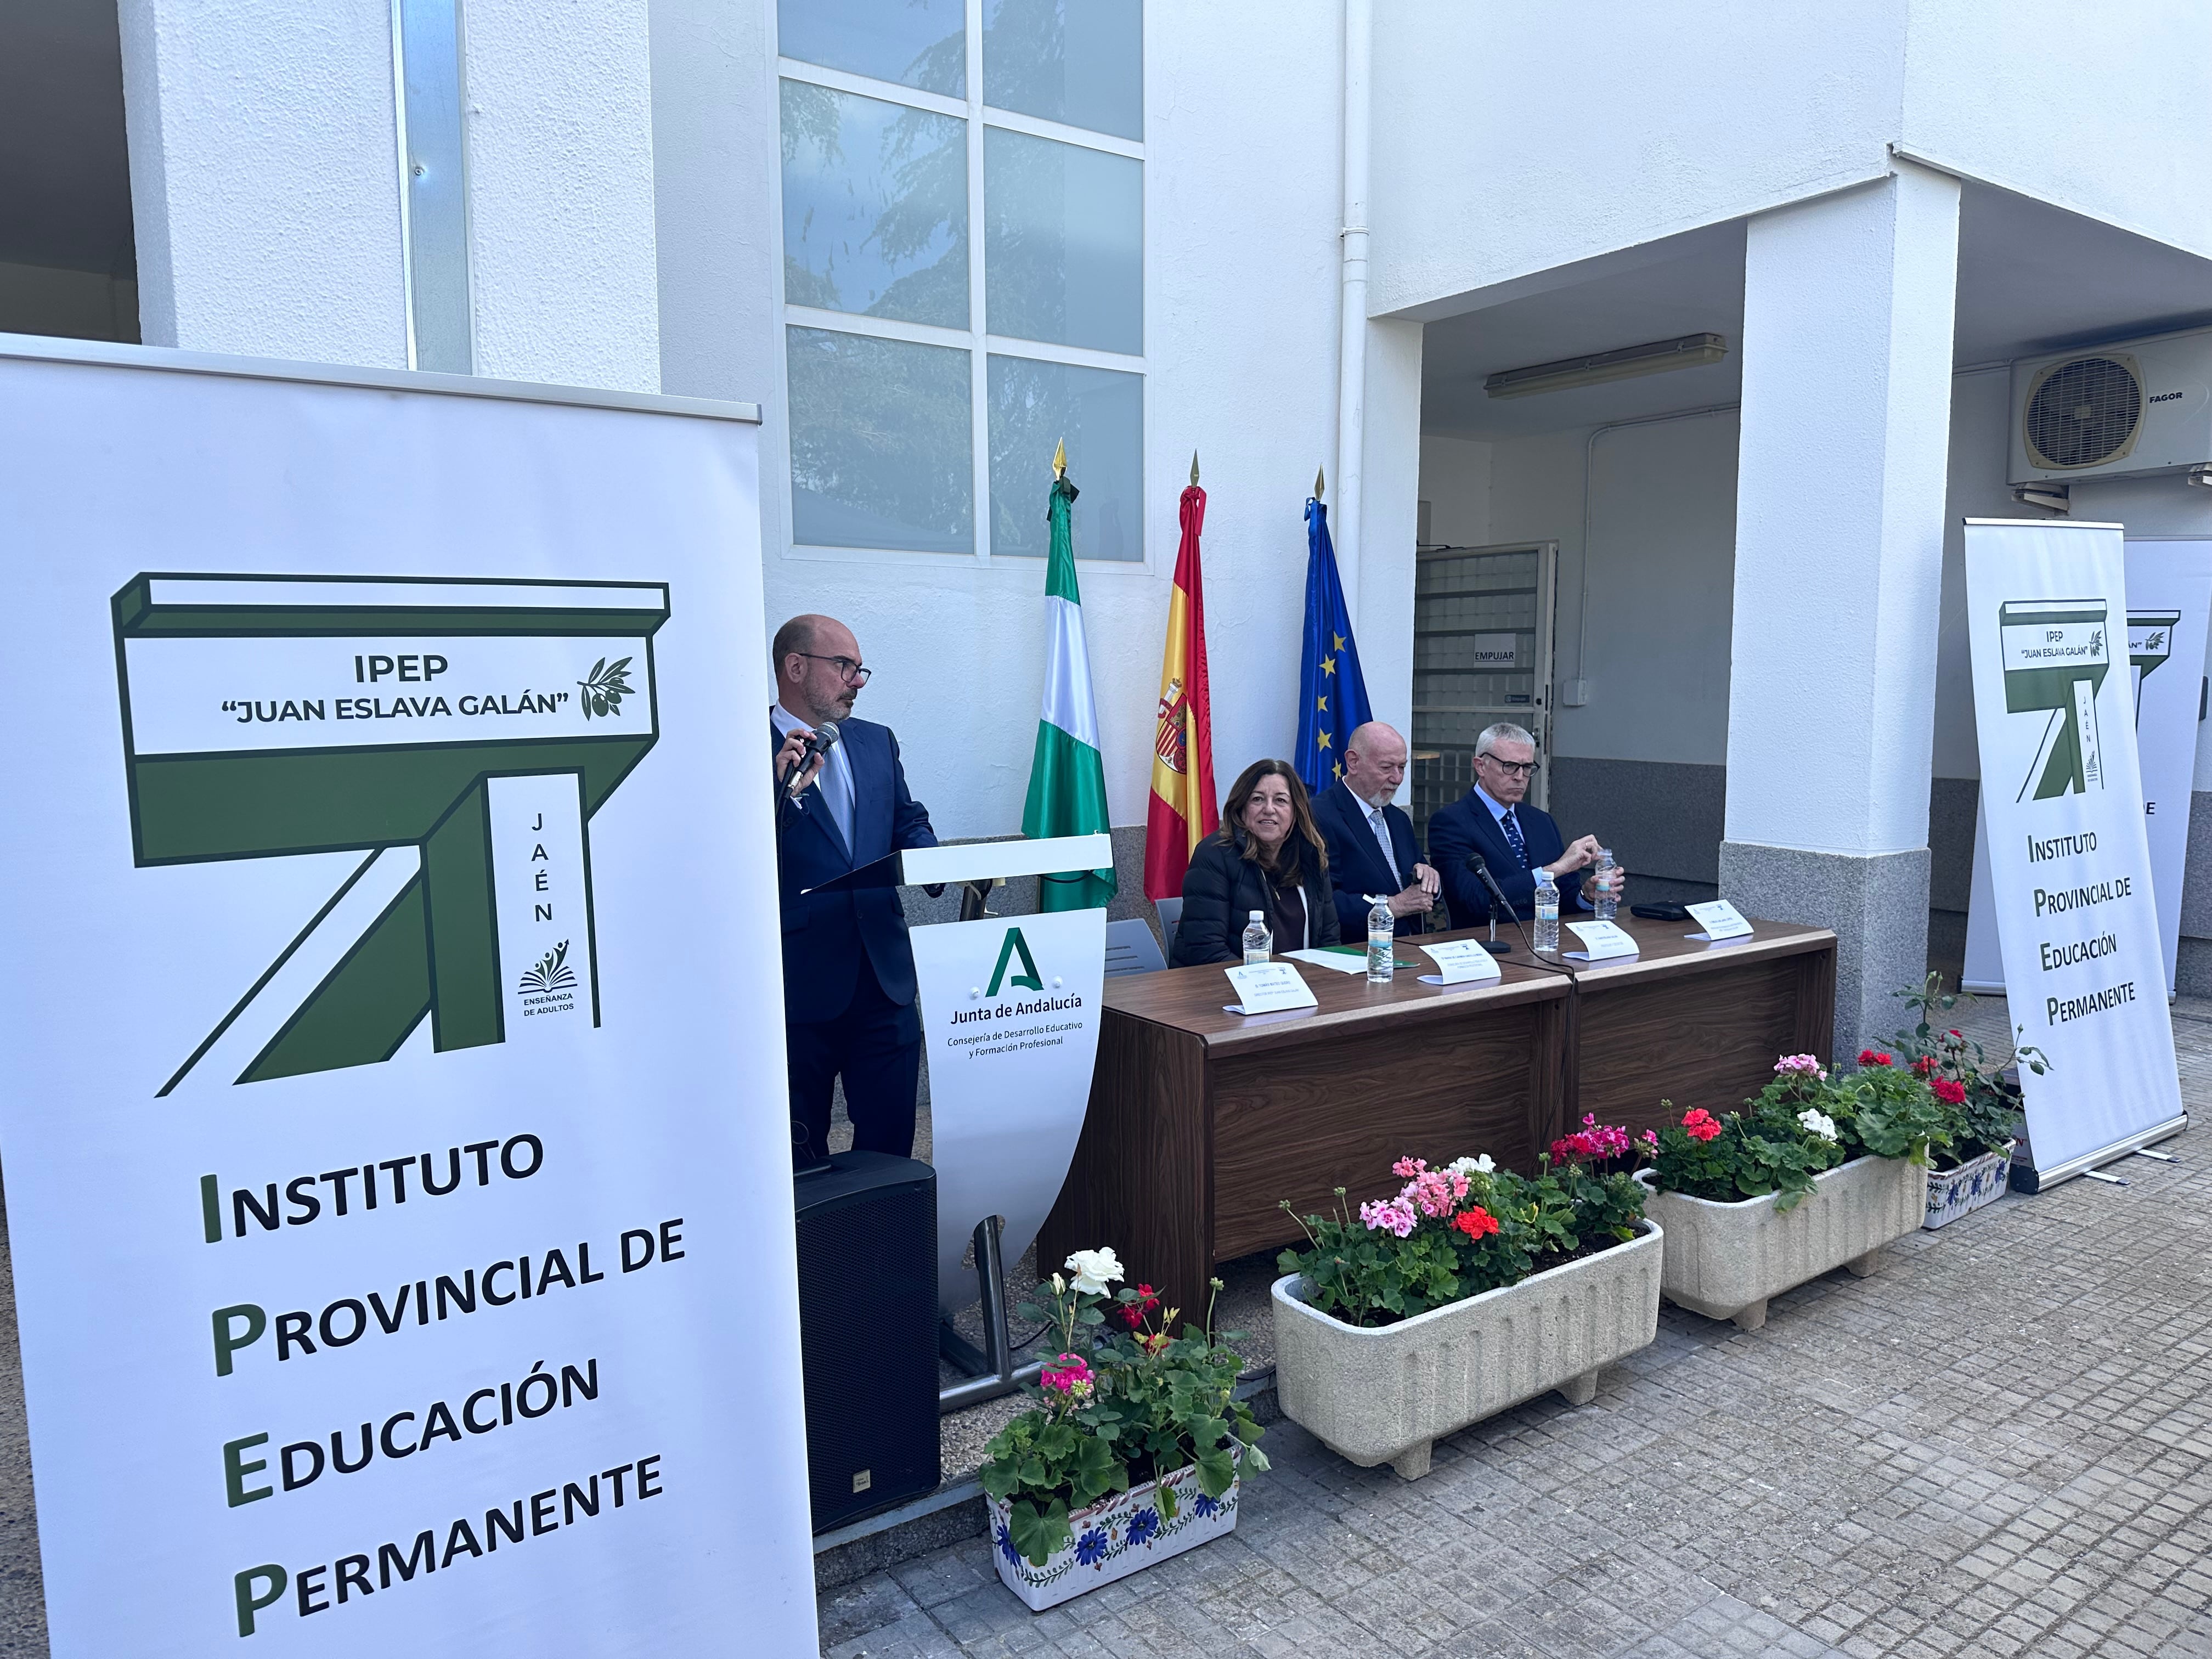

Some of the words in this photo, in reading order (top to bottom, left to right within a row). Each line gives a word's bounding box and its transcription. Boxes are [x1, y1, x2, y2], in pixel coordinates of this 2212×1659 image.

[2149, 392, 2182, 403] FAGOR
[2047, 631, 2063, 642] IPEP
[2022, 649, 2041, 658] “JUAN
[2043, 648, 2065, 657] ESLAVA
[2066, 646, 2087, 656] GALÁN”
[355, 655, 448, 682] IPEP
[222, 700, 325, 723] “JUAN
[336, 697, 452, 719] ESLAVA
[459, 690, 568, 715] GALÁN”
[2028, 832, 2096, 862] INSTITUTO
[2034, 882, 2113, 917] PROVINCIAL
[2115, 877, 2131, 898] DE
[2040, 931, 2116, 971] EDUCACIÓN
[524, 994, 573, 1005] ENSEÑANZA
[537, 1003, 573, 1014] ADULTOS
[951, 1008, 991, 1024] Junta
[996, 1004, 1012, 1018] de
[1016, 993, 1081, 1015] Andalucía
[2047, 982, 2135, 1025] PERMANENTE
[948, 1033, 990, 1046] Consejería
[992, 1032, 1002, 1040] de
[1005, 1026, 1043, 1038] Desarrollo
[1046, 1023, 1082, 1032] Educativo
[969, 1051, 974, 1059] y
[976, 1043, 1017, 1056] Formación
[1020, 1036, 1063, 1049] Profesional
[201, 1135, 543, 1243] INSTITUTO
[212, 1243, 603, 1376] PROVINCIAL
[621, 1218, 685, 1273] DE
[224, 1359, 598, 1508] EDUCACIÓN
[235, 1454, 662, 1637] PERMANENTE
